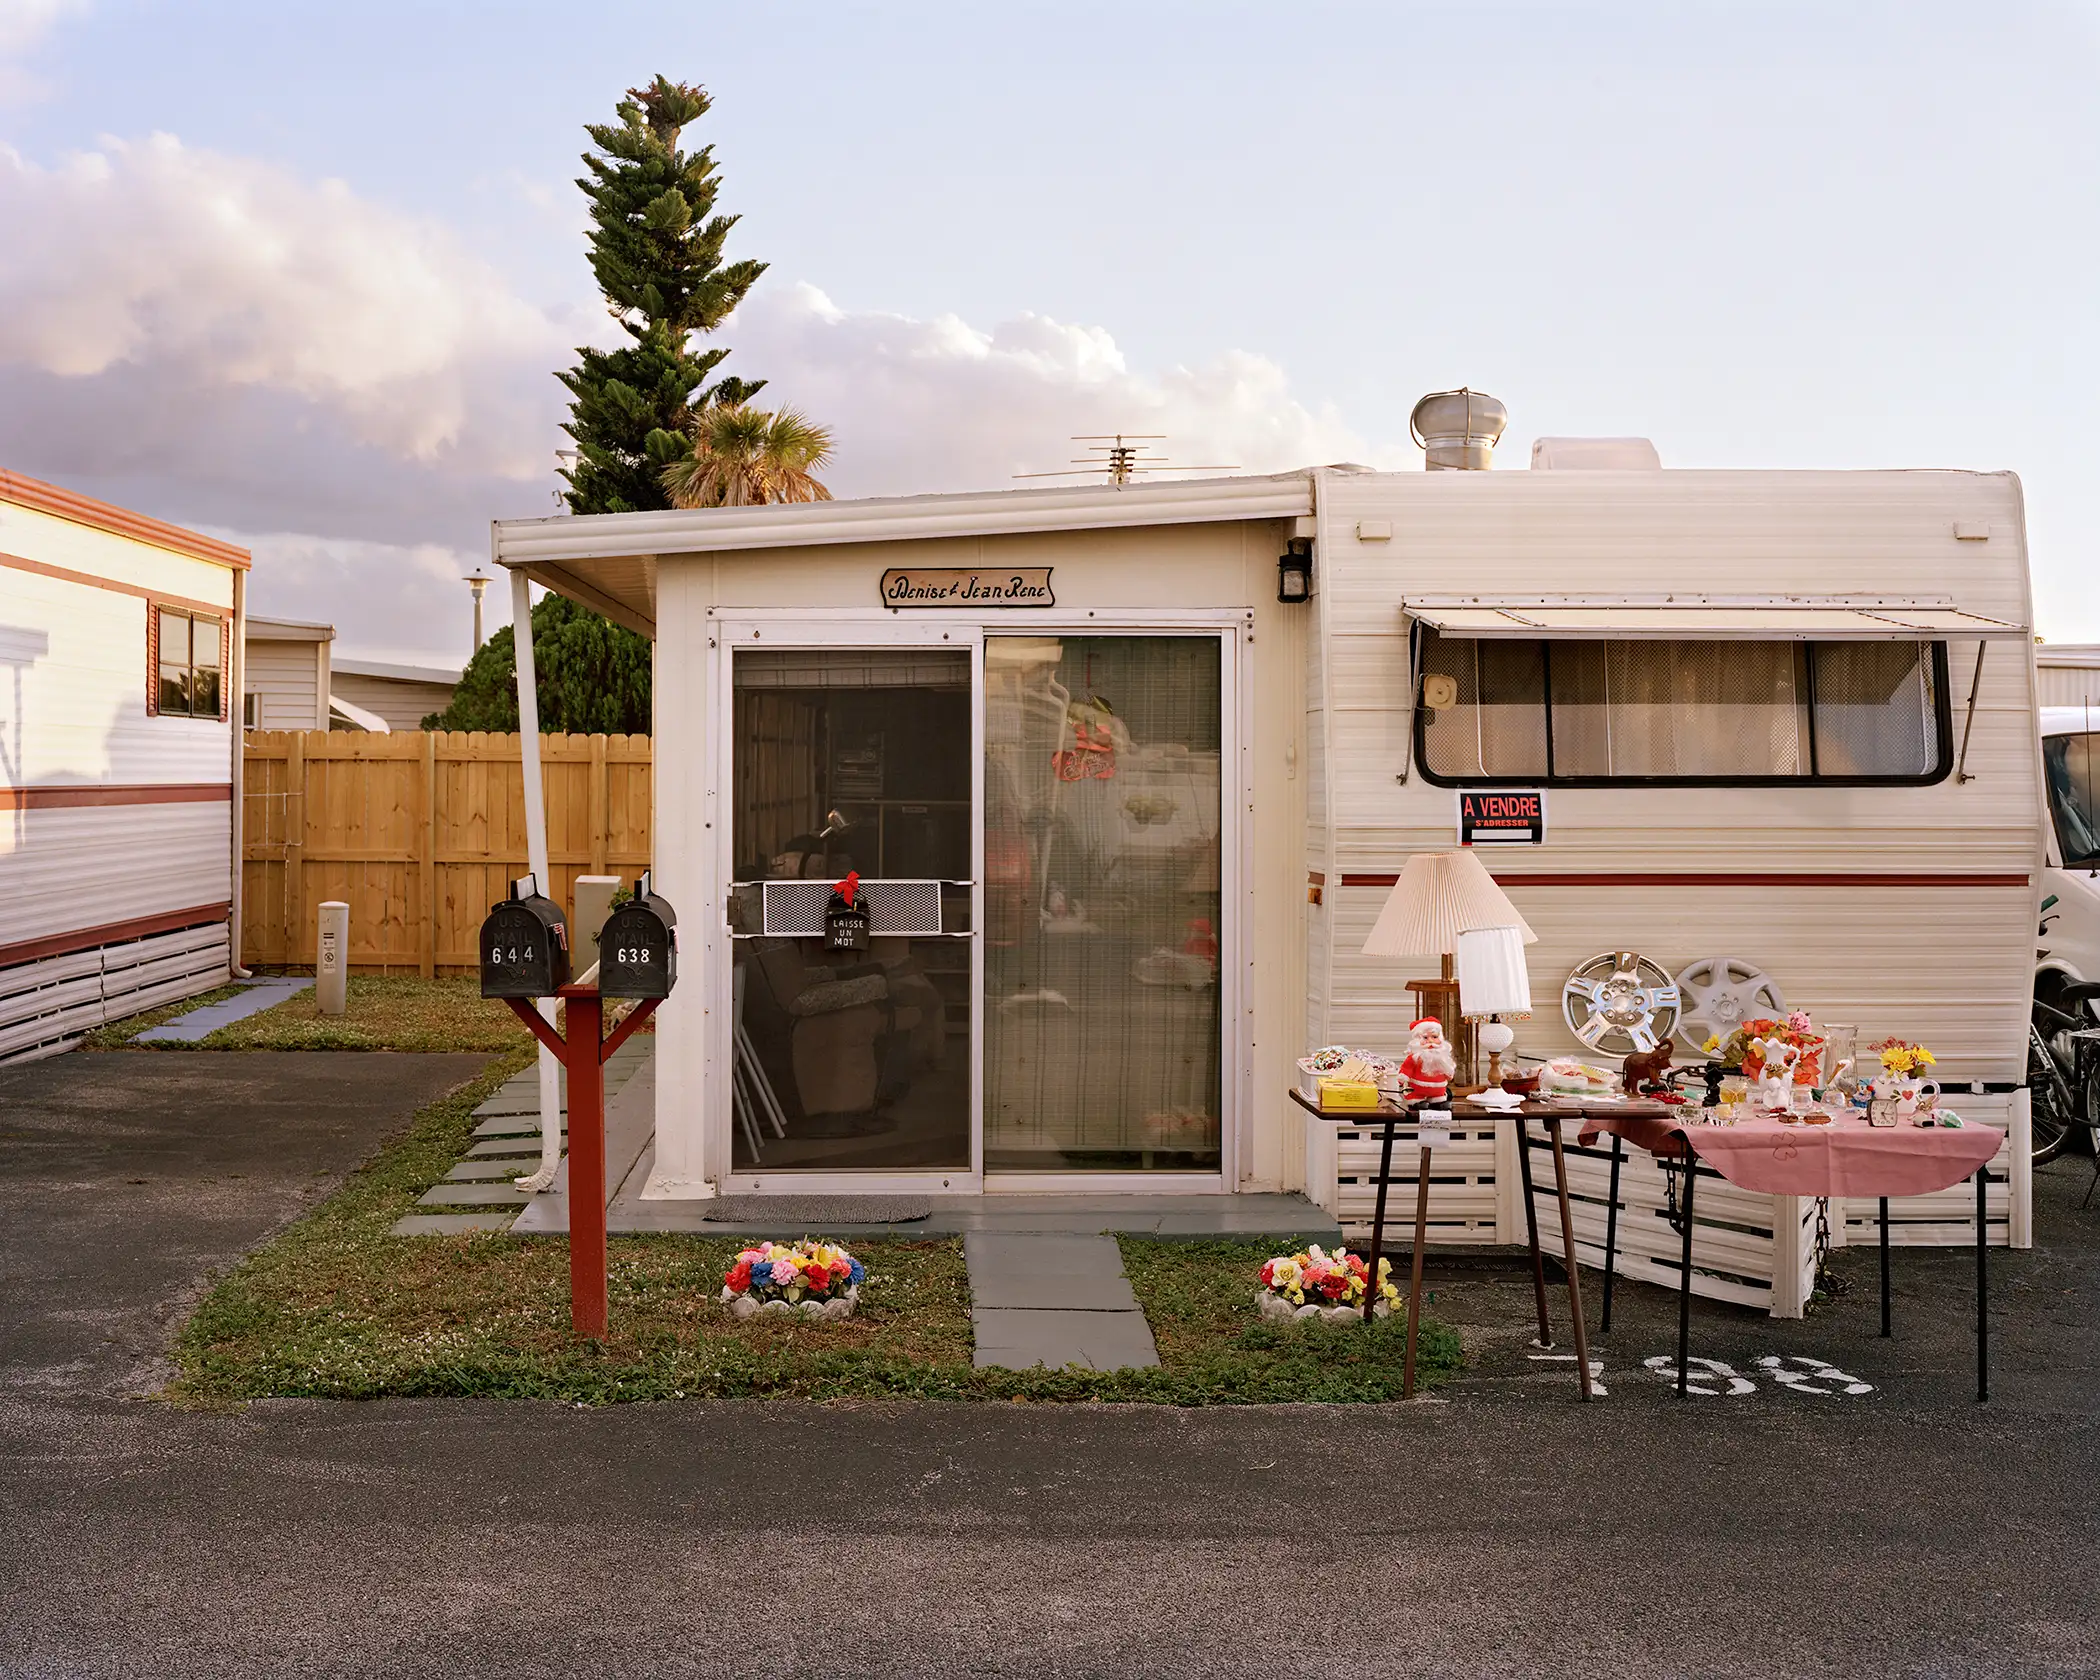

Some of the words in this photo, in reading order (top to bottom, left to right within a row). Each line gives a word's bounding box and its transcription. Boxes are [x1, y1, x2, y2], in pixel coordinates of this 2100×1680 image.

[888, 576, 947, 599] Denise
[961, 576, 1001, 599] Jean
[1004, 576, 1045, 598] Rene
[1463, 796, 1475, 817] A
[1479, 797, 1540, 817] VENDRE
[493, 931, 534, 946] MAIL
[614, 932, 655, 945] MAIL
[839, 929, 852, 937] UN
[834, 937, 854, 946] MOT
[492, 946, 533, 964] 644
[618, 948, 650, 963] 638
